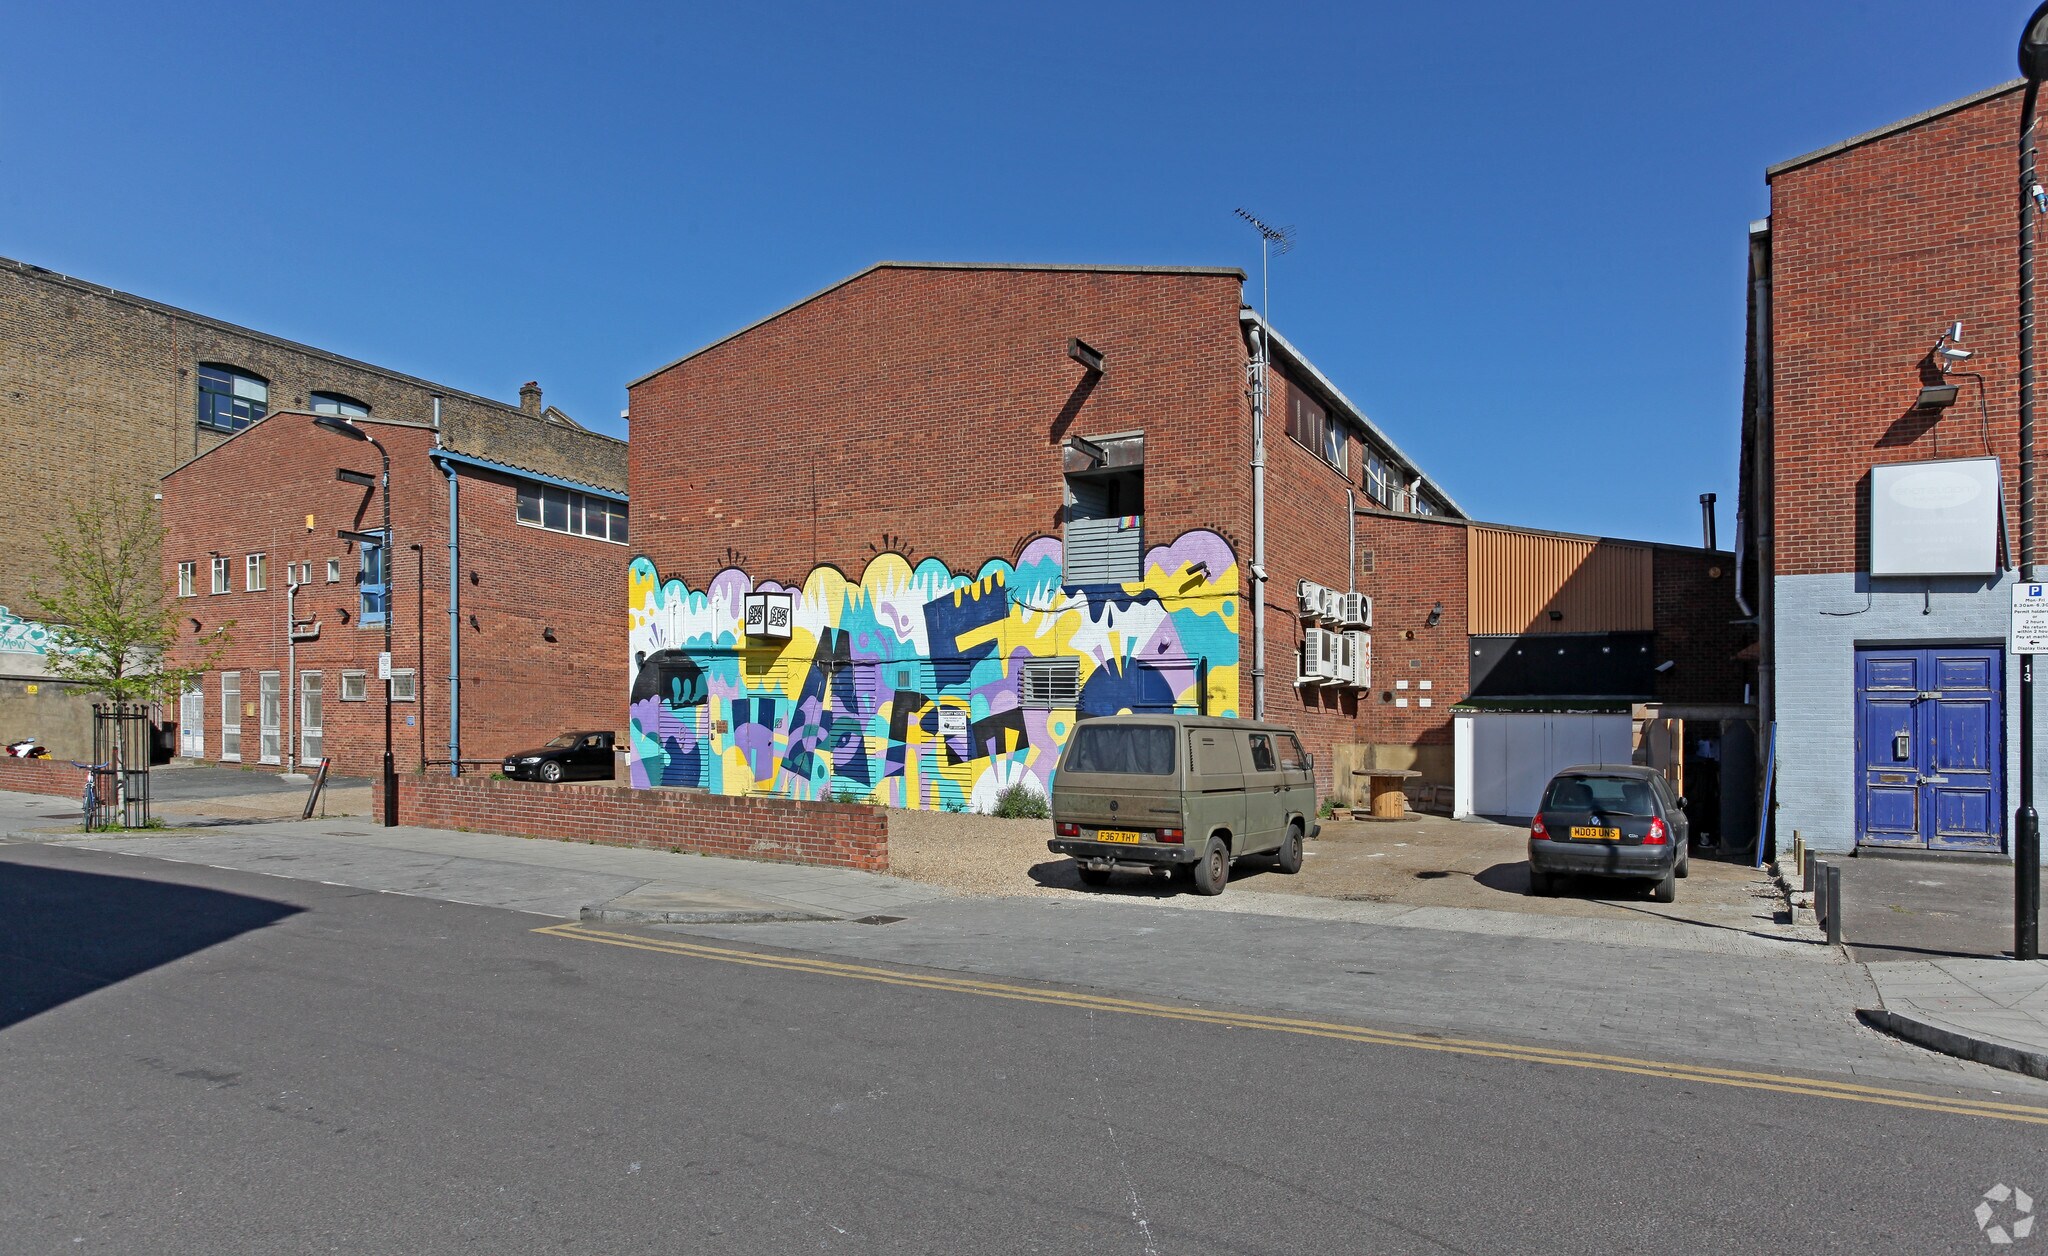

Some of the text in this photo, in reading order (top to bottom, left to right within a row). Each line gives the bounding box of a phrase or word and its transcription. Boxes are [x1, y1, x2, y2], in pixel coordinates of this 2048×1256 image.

[2031, 586, 2040, 596] P
[1100, 831, 1136, 843] F367 THY
[1598, 828, 1615, 837] UNS
